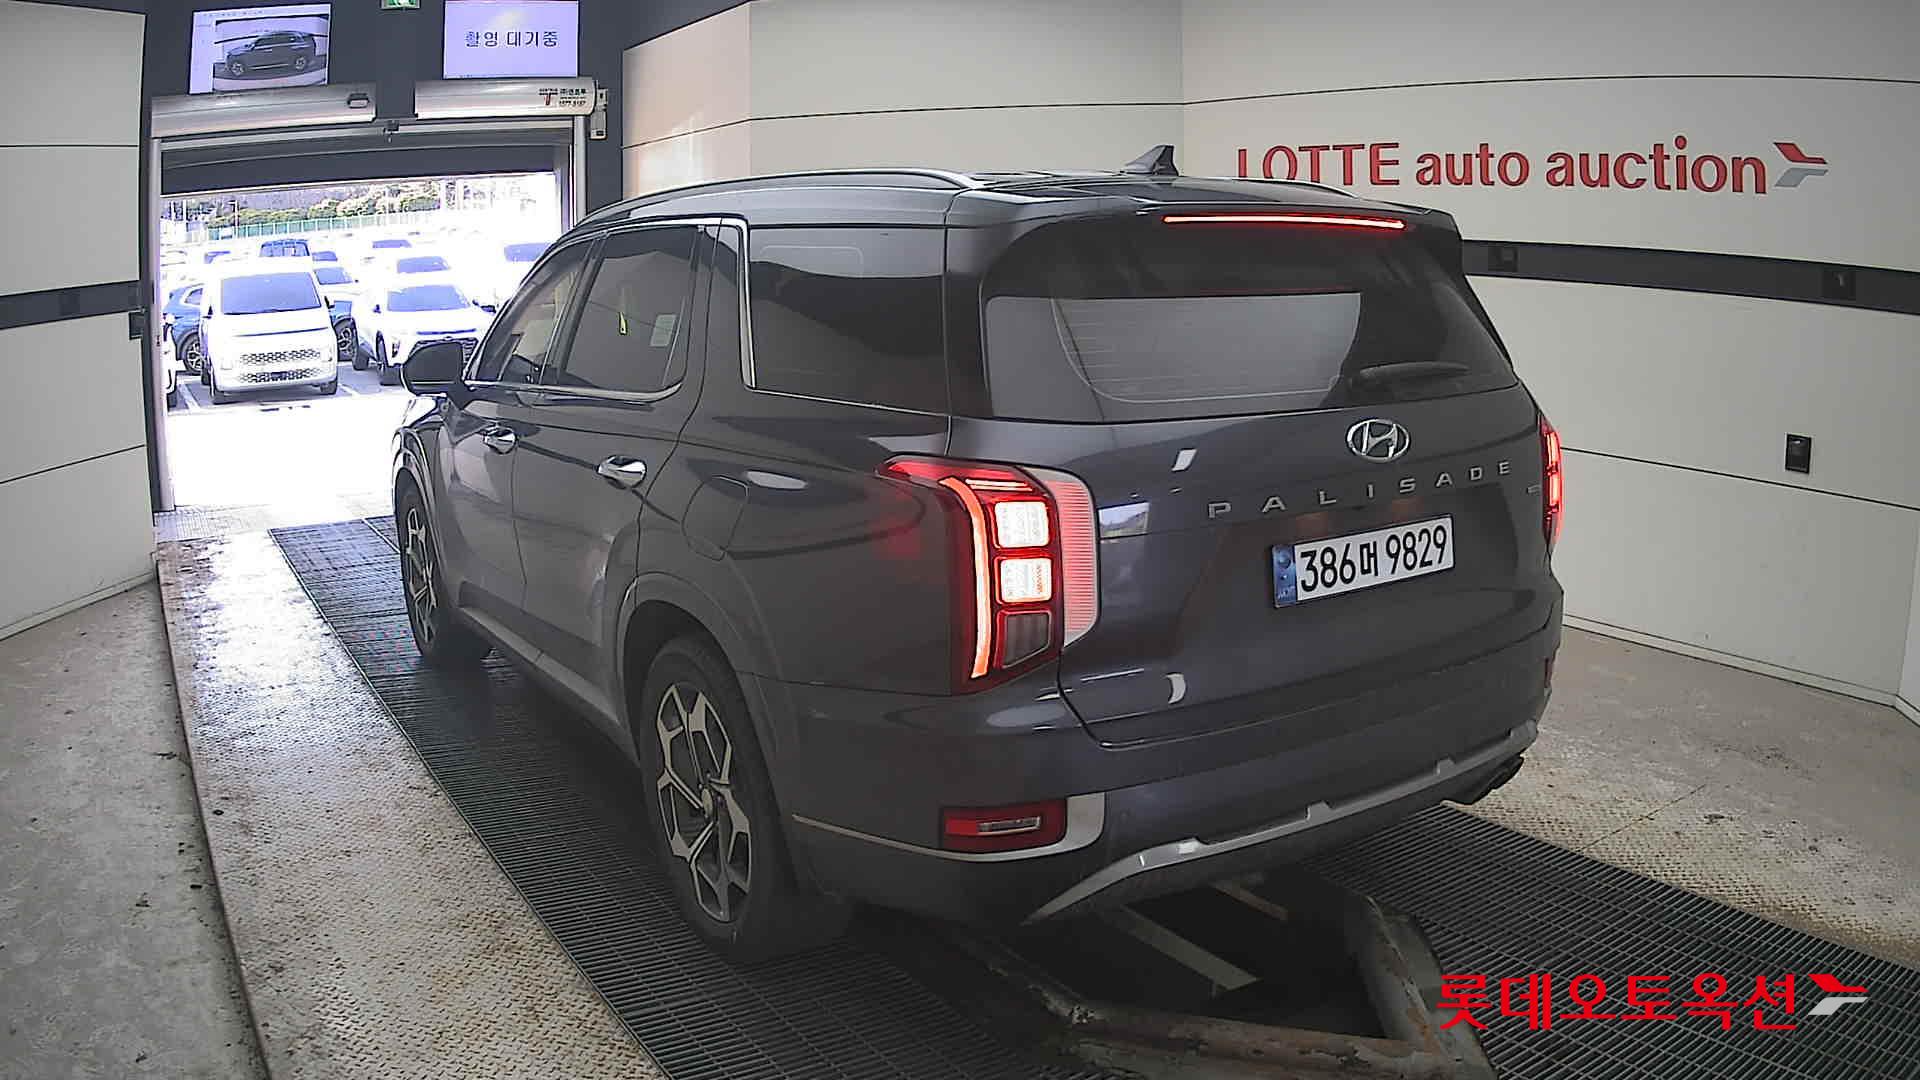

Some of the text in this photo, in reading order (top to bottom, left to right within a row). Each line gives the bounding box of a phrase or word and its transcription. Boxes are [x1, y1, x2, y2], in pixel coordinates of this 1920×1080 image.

[506, 30, 559, 48] 대기중
[1415, 144, 1531, 188] auto
[1546, 135, 1768, 194] auction
[1207, 461, 1513, 520] PALISADE
[1300, 525, 1447, 592] 386머 9829
